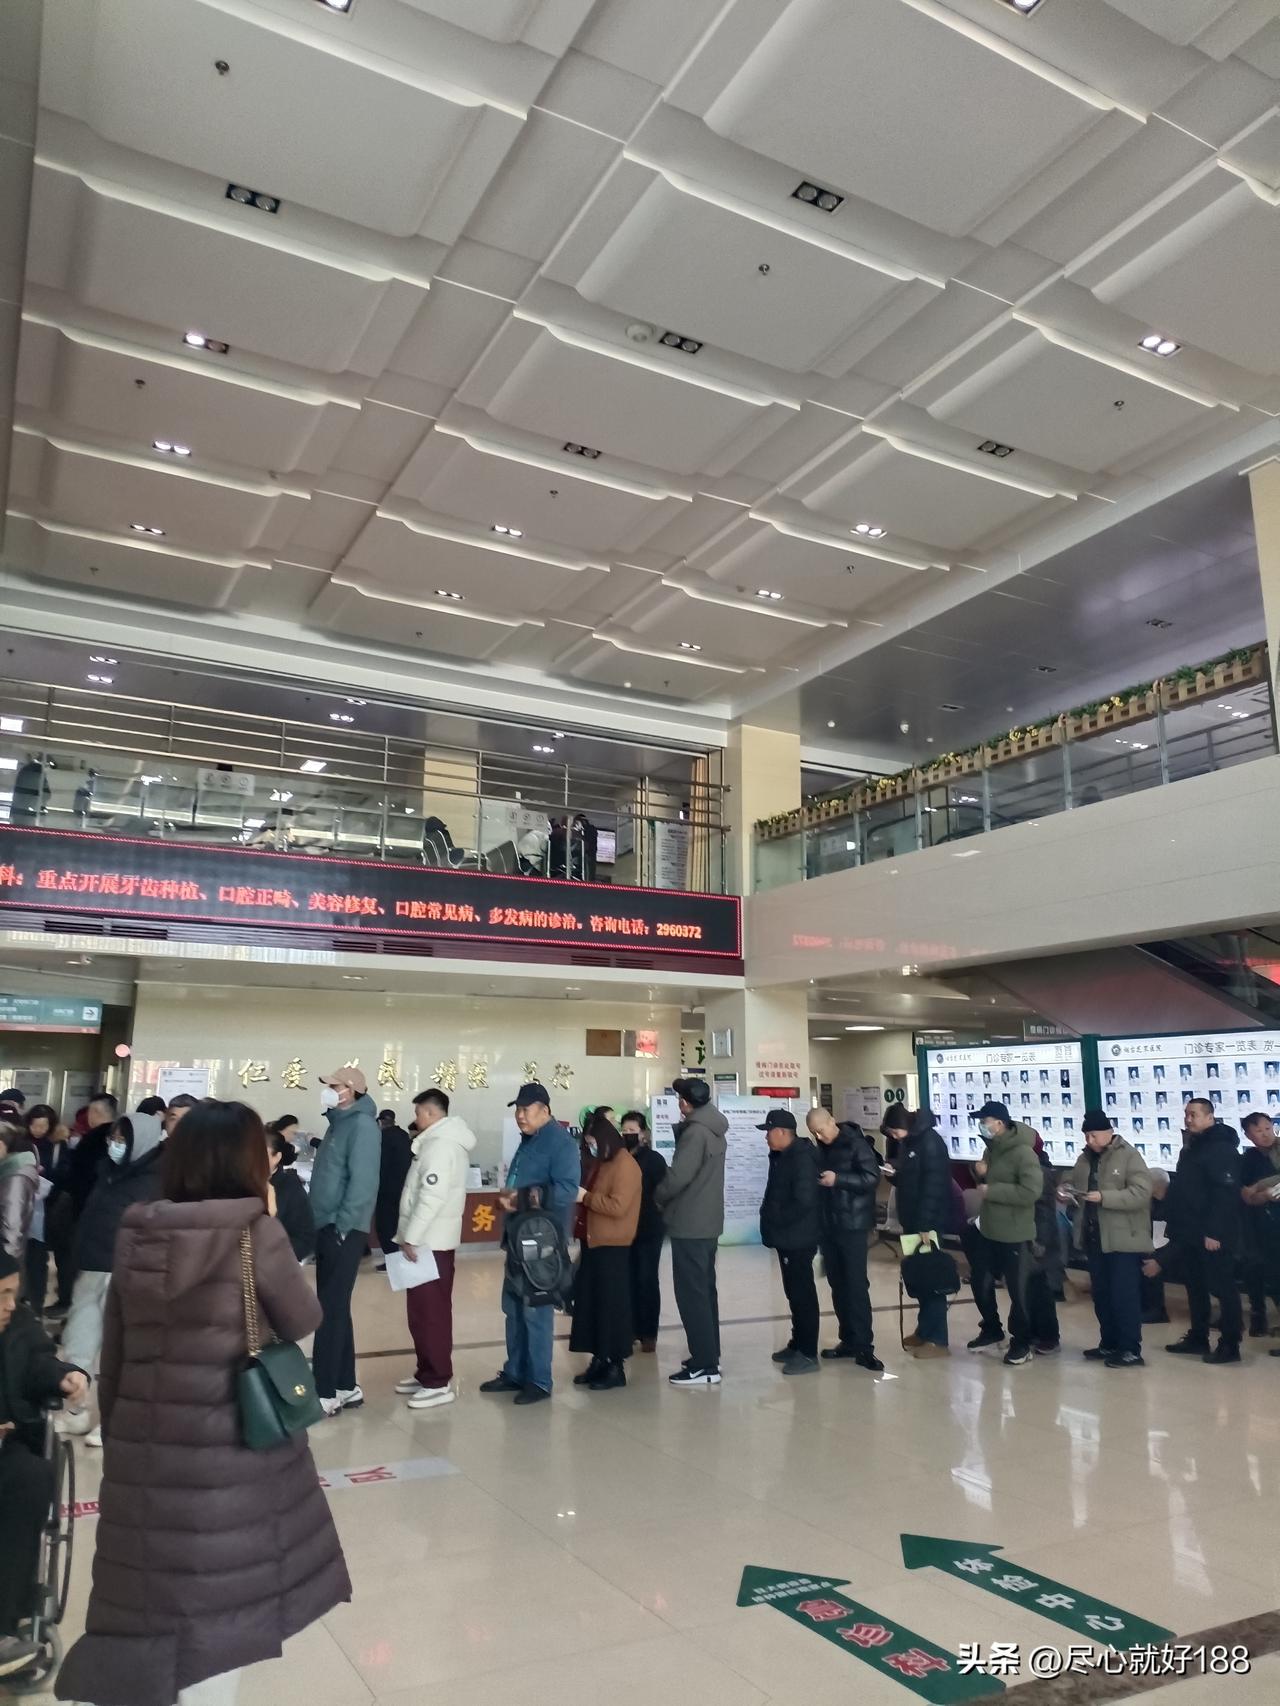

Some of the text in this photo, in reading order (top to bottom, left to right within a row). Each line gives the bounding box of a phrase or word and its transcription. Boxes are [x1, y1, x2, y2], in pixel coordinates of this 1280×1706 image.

[1184, 1040, 1257, 1054] 门诊专家一览表
[472, 1204, 496, 1232] 务
[953, 1557, 1126, 1632] 体检中心
[795, 1598, 952, 1679] 急诊科
